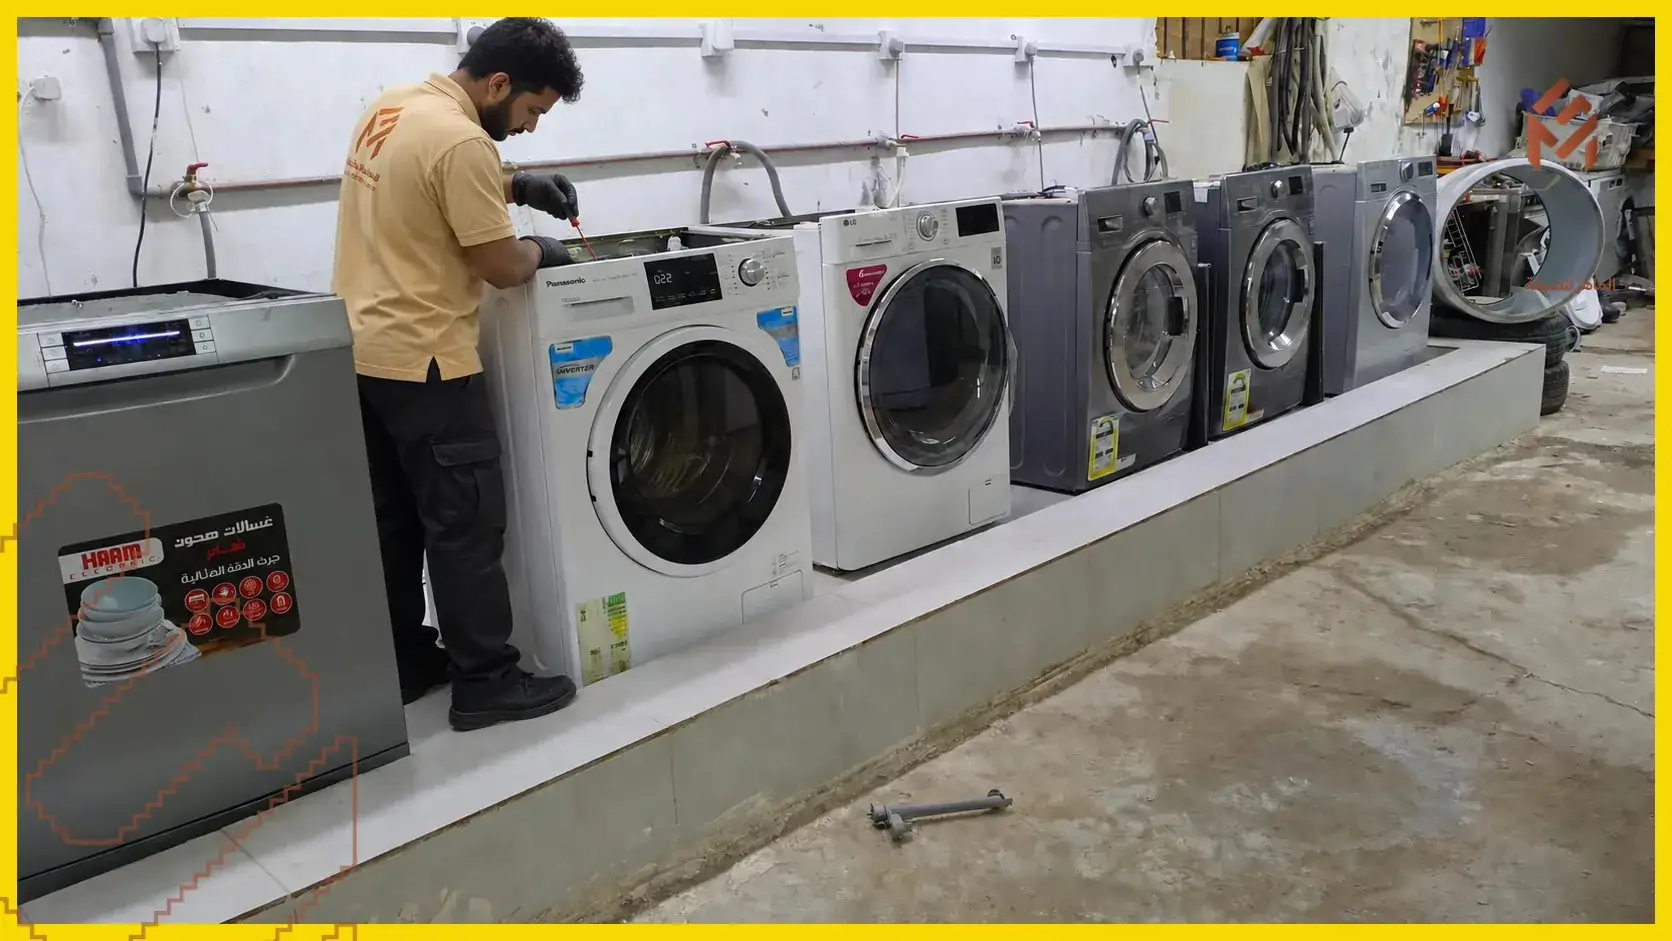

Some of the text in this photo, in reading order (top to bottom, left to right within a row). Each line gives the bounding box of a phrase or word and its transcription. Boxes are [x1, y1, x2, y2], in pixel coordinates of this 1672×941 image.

[546, 277, 586, 288] Panasonic
[224, 515, 273, 536] غسالات
[81, 543, 142, 570] HAAM
